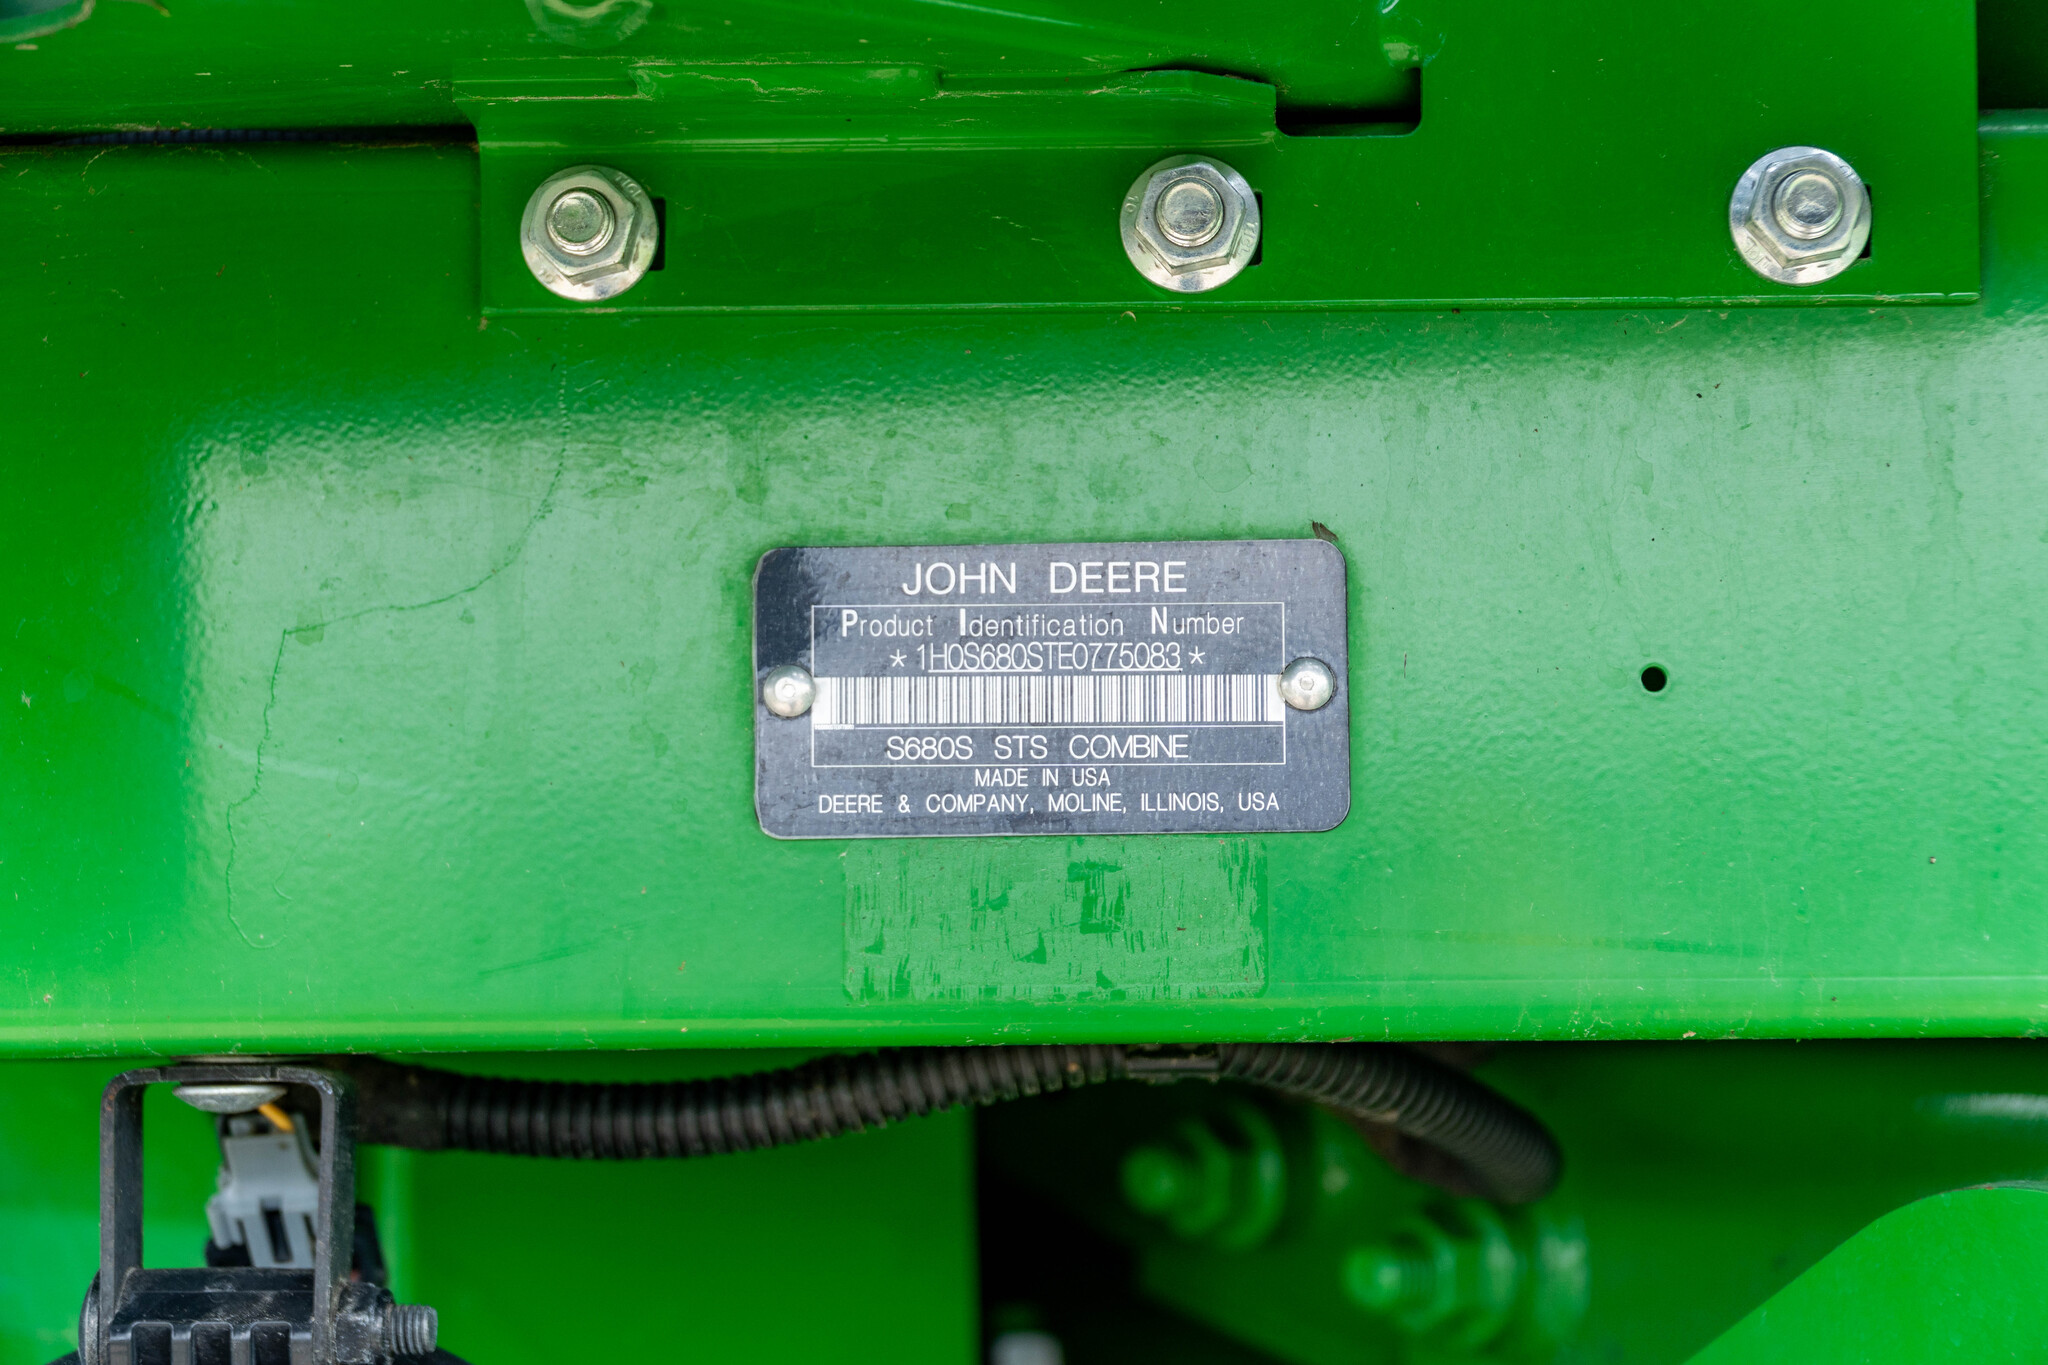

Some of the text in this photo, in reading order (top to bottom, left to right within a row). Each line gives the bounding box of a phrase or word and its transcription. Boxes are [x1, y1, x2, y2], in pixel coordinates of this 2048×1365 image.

[902, 560, 1188, 595] JOHN DEERE
[842, 606, 1245, 637] Product Identification Number
[917, 641, 1182, 671] 1H0S680STE0775083
[887, 734, 1189, 760] S680S STS COMBINE
[975, 767, 1111, 787] MADE IN USA
[819, 792, 1279, 815] DEERE & COMPANY, MOLINE, ILLINOIS, USA
